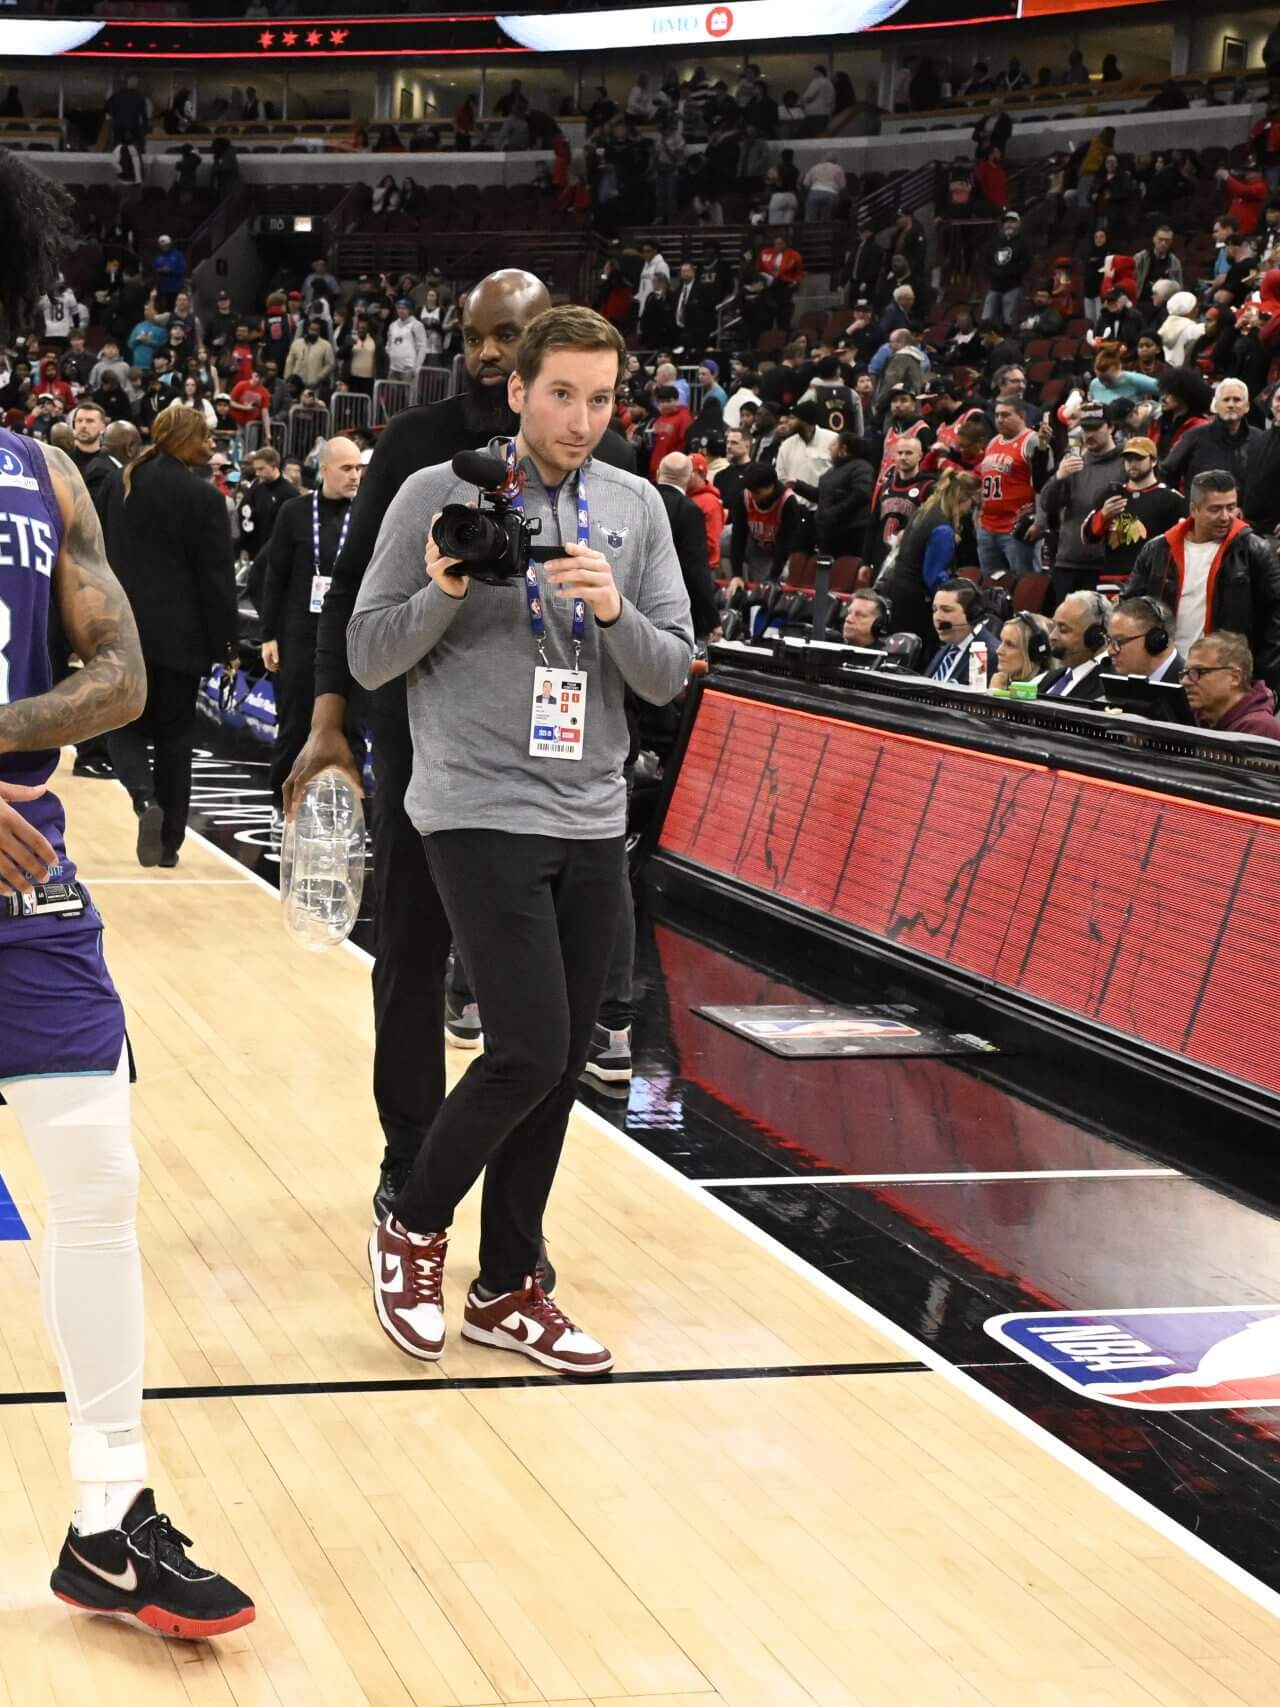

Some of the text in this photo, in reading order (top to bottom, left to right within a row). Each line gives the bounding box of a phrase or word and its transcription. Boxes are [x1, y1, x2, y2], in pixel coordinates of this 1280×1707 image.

[651, 17, 699, 33] BMO
[982, 475, 1003, 500] 91
[1026, 1324, 1176, 1372] NBA
